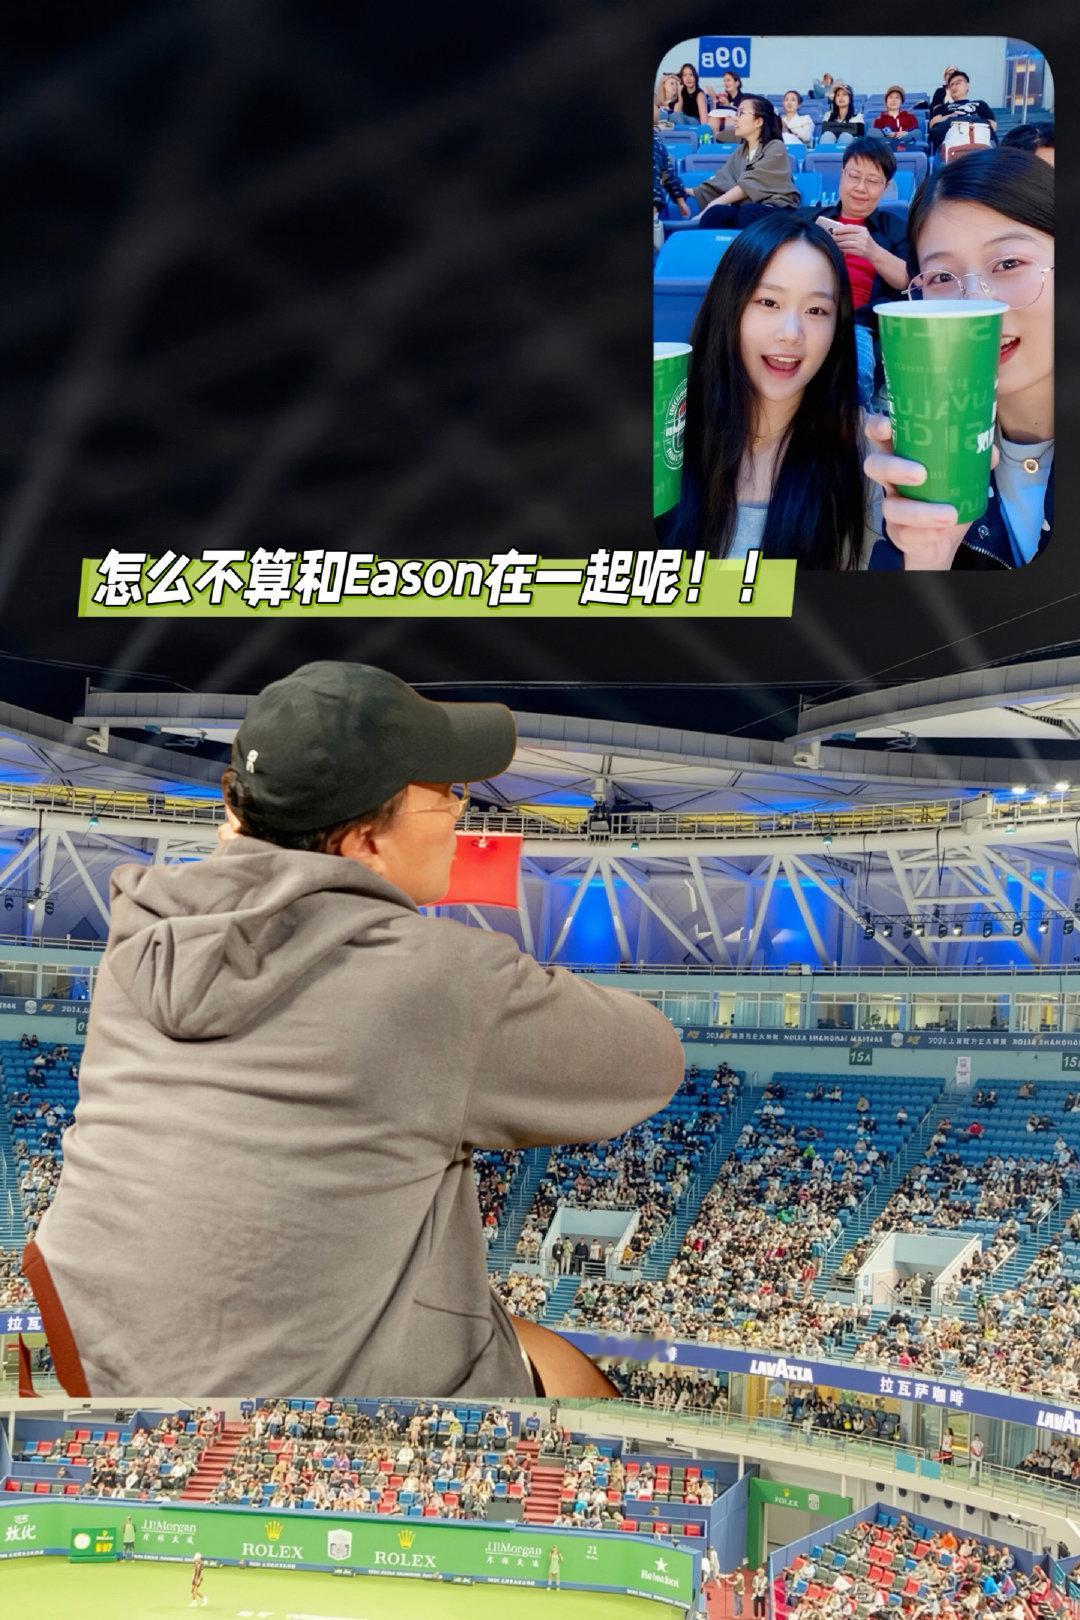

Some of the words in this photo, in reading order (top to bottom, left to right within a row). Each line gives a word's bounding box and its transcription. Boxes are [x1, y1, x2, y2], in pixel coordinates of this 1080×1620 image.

[1064, 1056, 1080, 1068] 15
[749, 1358, 813, 1383] LAVAZZA
[880, 1376, 964, 1407] 拉瓦萨咖啡
[242, 1542, 304, 1559] ROLEX
[374, 1551, 437, 1568] ROLEX
